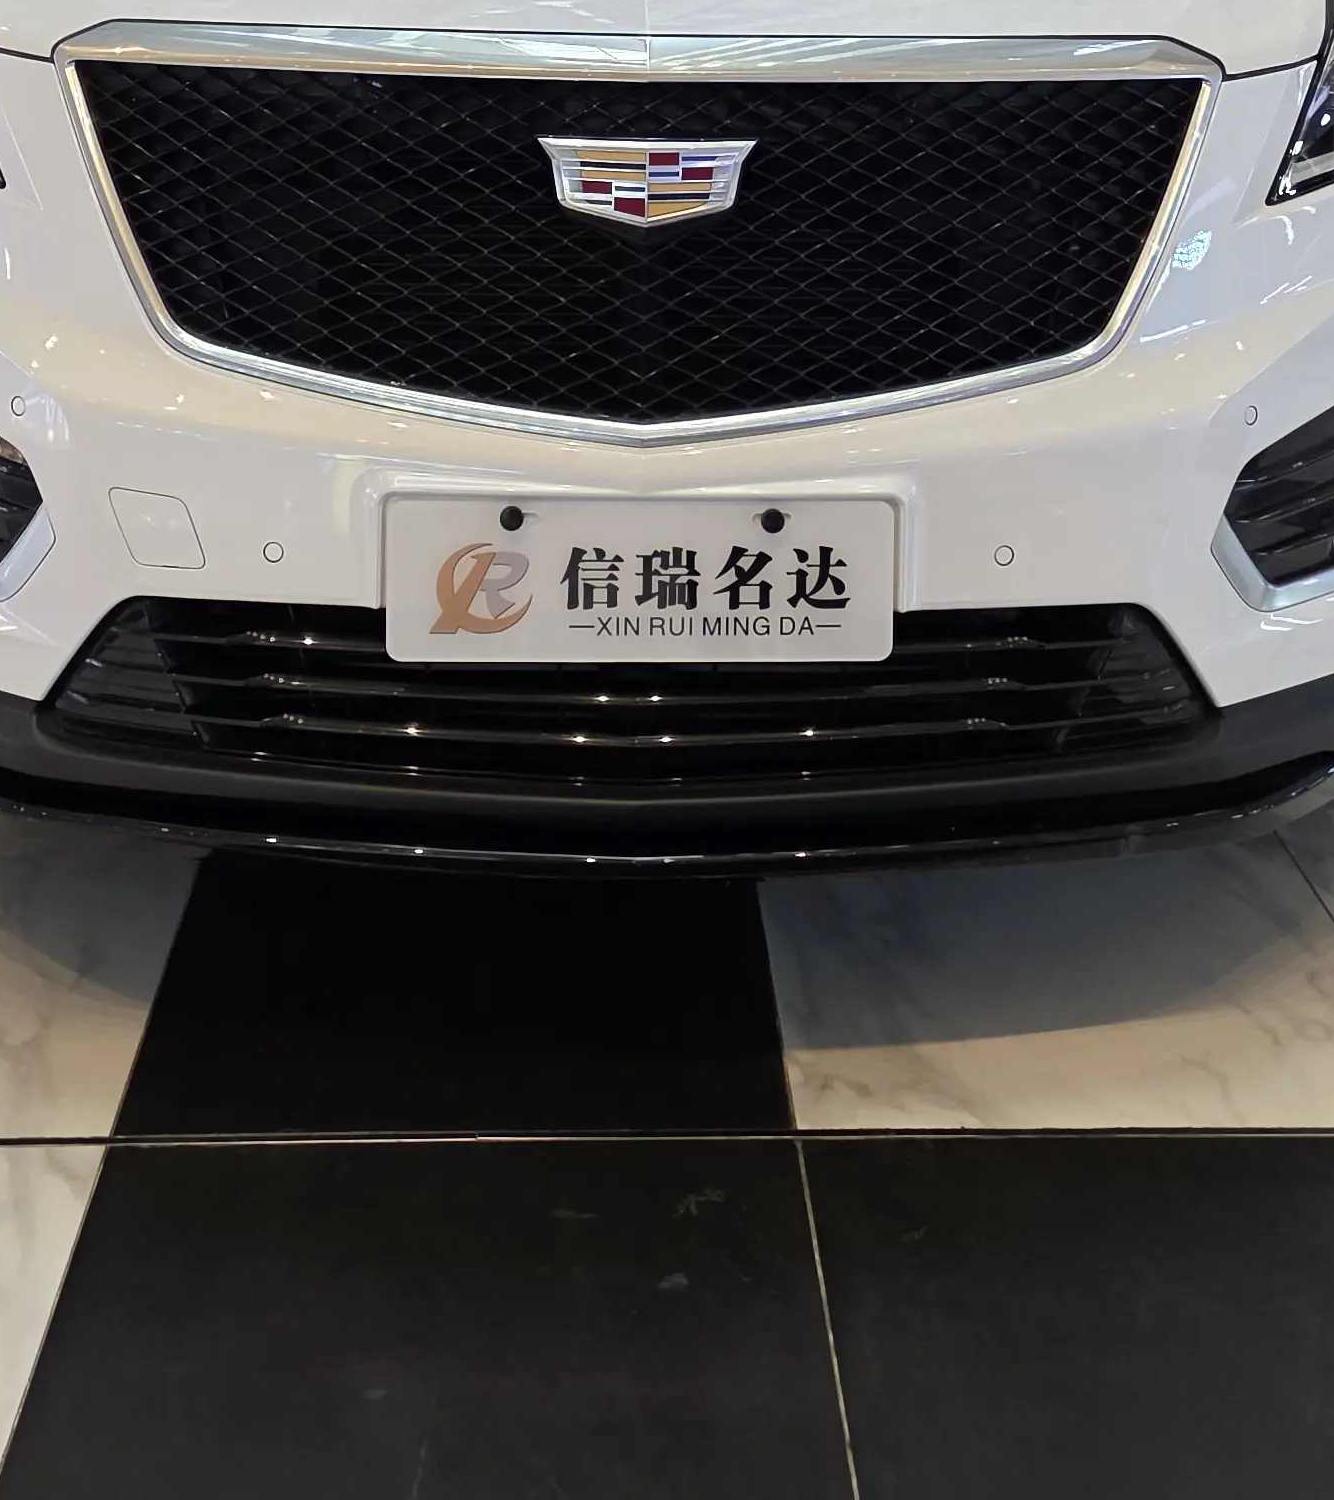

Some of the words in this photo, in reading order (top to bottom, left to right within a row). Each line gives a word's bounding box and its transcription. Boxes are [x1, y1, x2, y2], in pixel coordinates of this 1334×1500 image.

[560, 546, 851, 611] 信瑞名达
[596, 616, 640, 636] XIN
[649, 616, 694, 636] RUI
[702, 616, 771, 637] MING
[779, 616, 815, 636] DA
